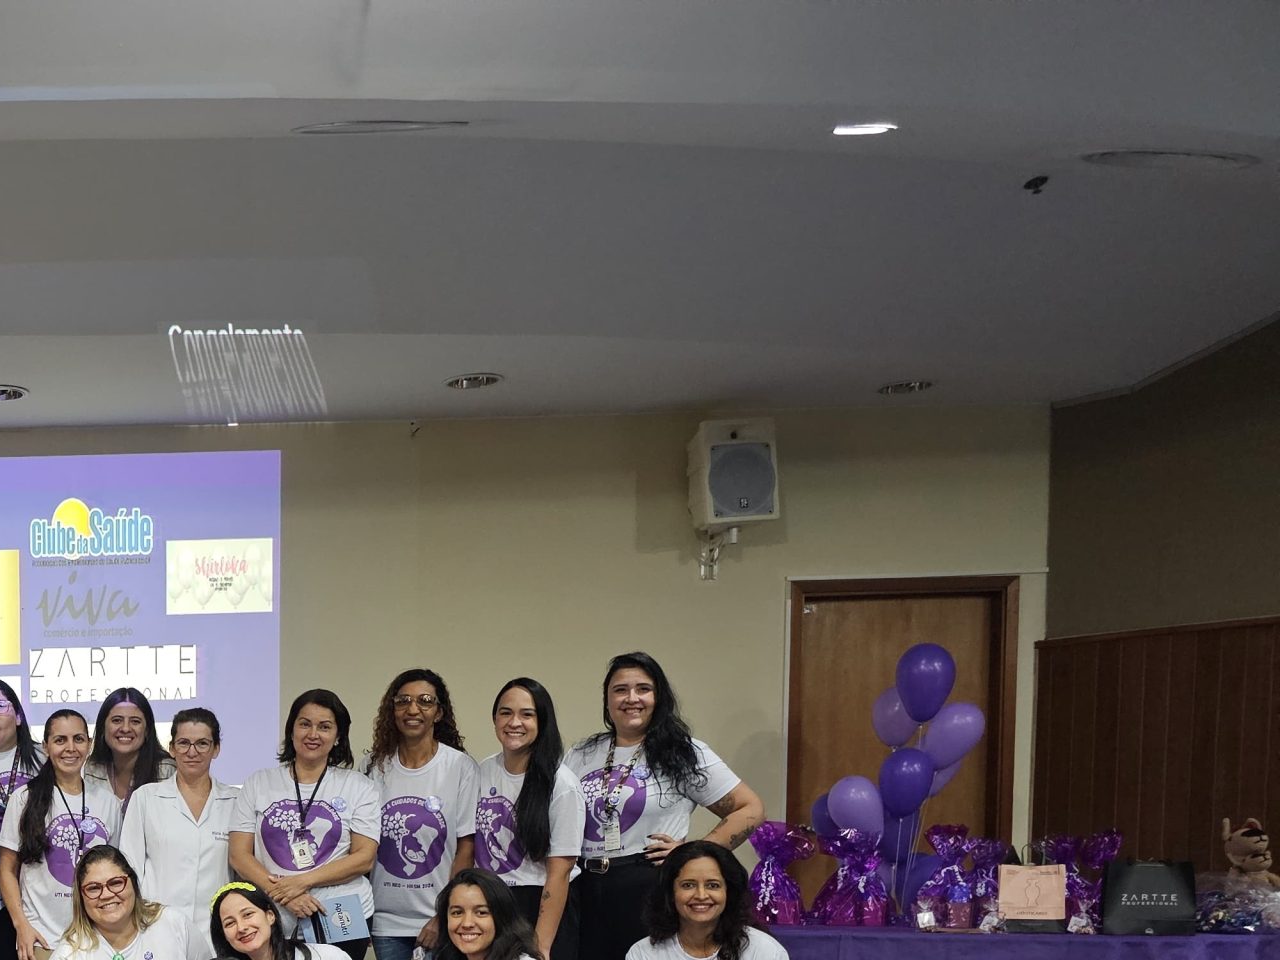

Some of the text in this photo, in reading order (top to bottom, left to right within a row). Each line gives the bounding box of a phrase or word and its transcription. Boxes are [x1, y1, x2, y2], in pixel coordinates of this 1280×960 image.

[31, 509, 152, 557] Clube da Saúde
[36, 570, 140, 628] viva
[30, 644, 195, 678] ZARTTE
[31, 686, 196, 703] PROFESONAL
[391, 797, 418, 807] CUIDADOS
[1121, 893, 1178, 902] ZARTTE
[334, 902, 350, 936] Aptanutri
